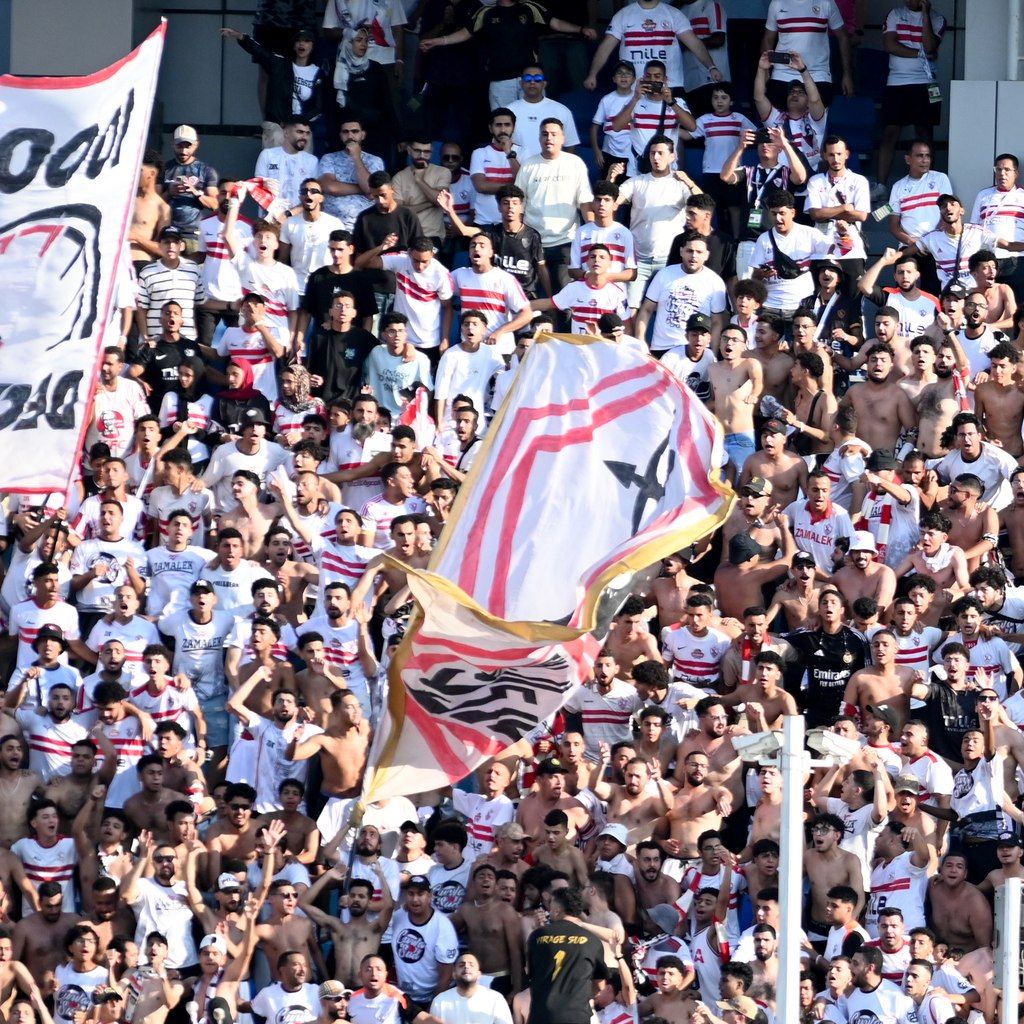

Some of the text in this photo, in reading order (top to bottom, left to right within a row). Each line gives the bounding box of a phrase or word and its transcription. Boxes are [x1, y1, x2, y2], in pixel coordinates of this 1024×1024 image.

[795, 528, 833, 547] ZAMALEK
[182, 636, 223, 651] ZAMALEK
[814, 668, 851, 681] Emirates
